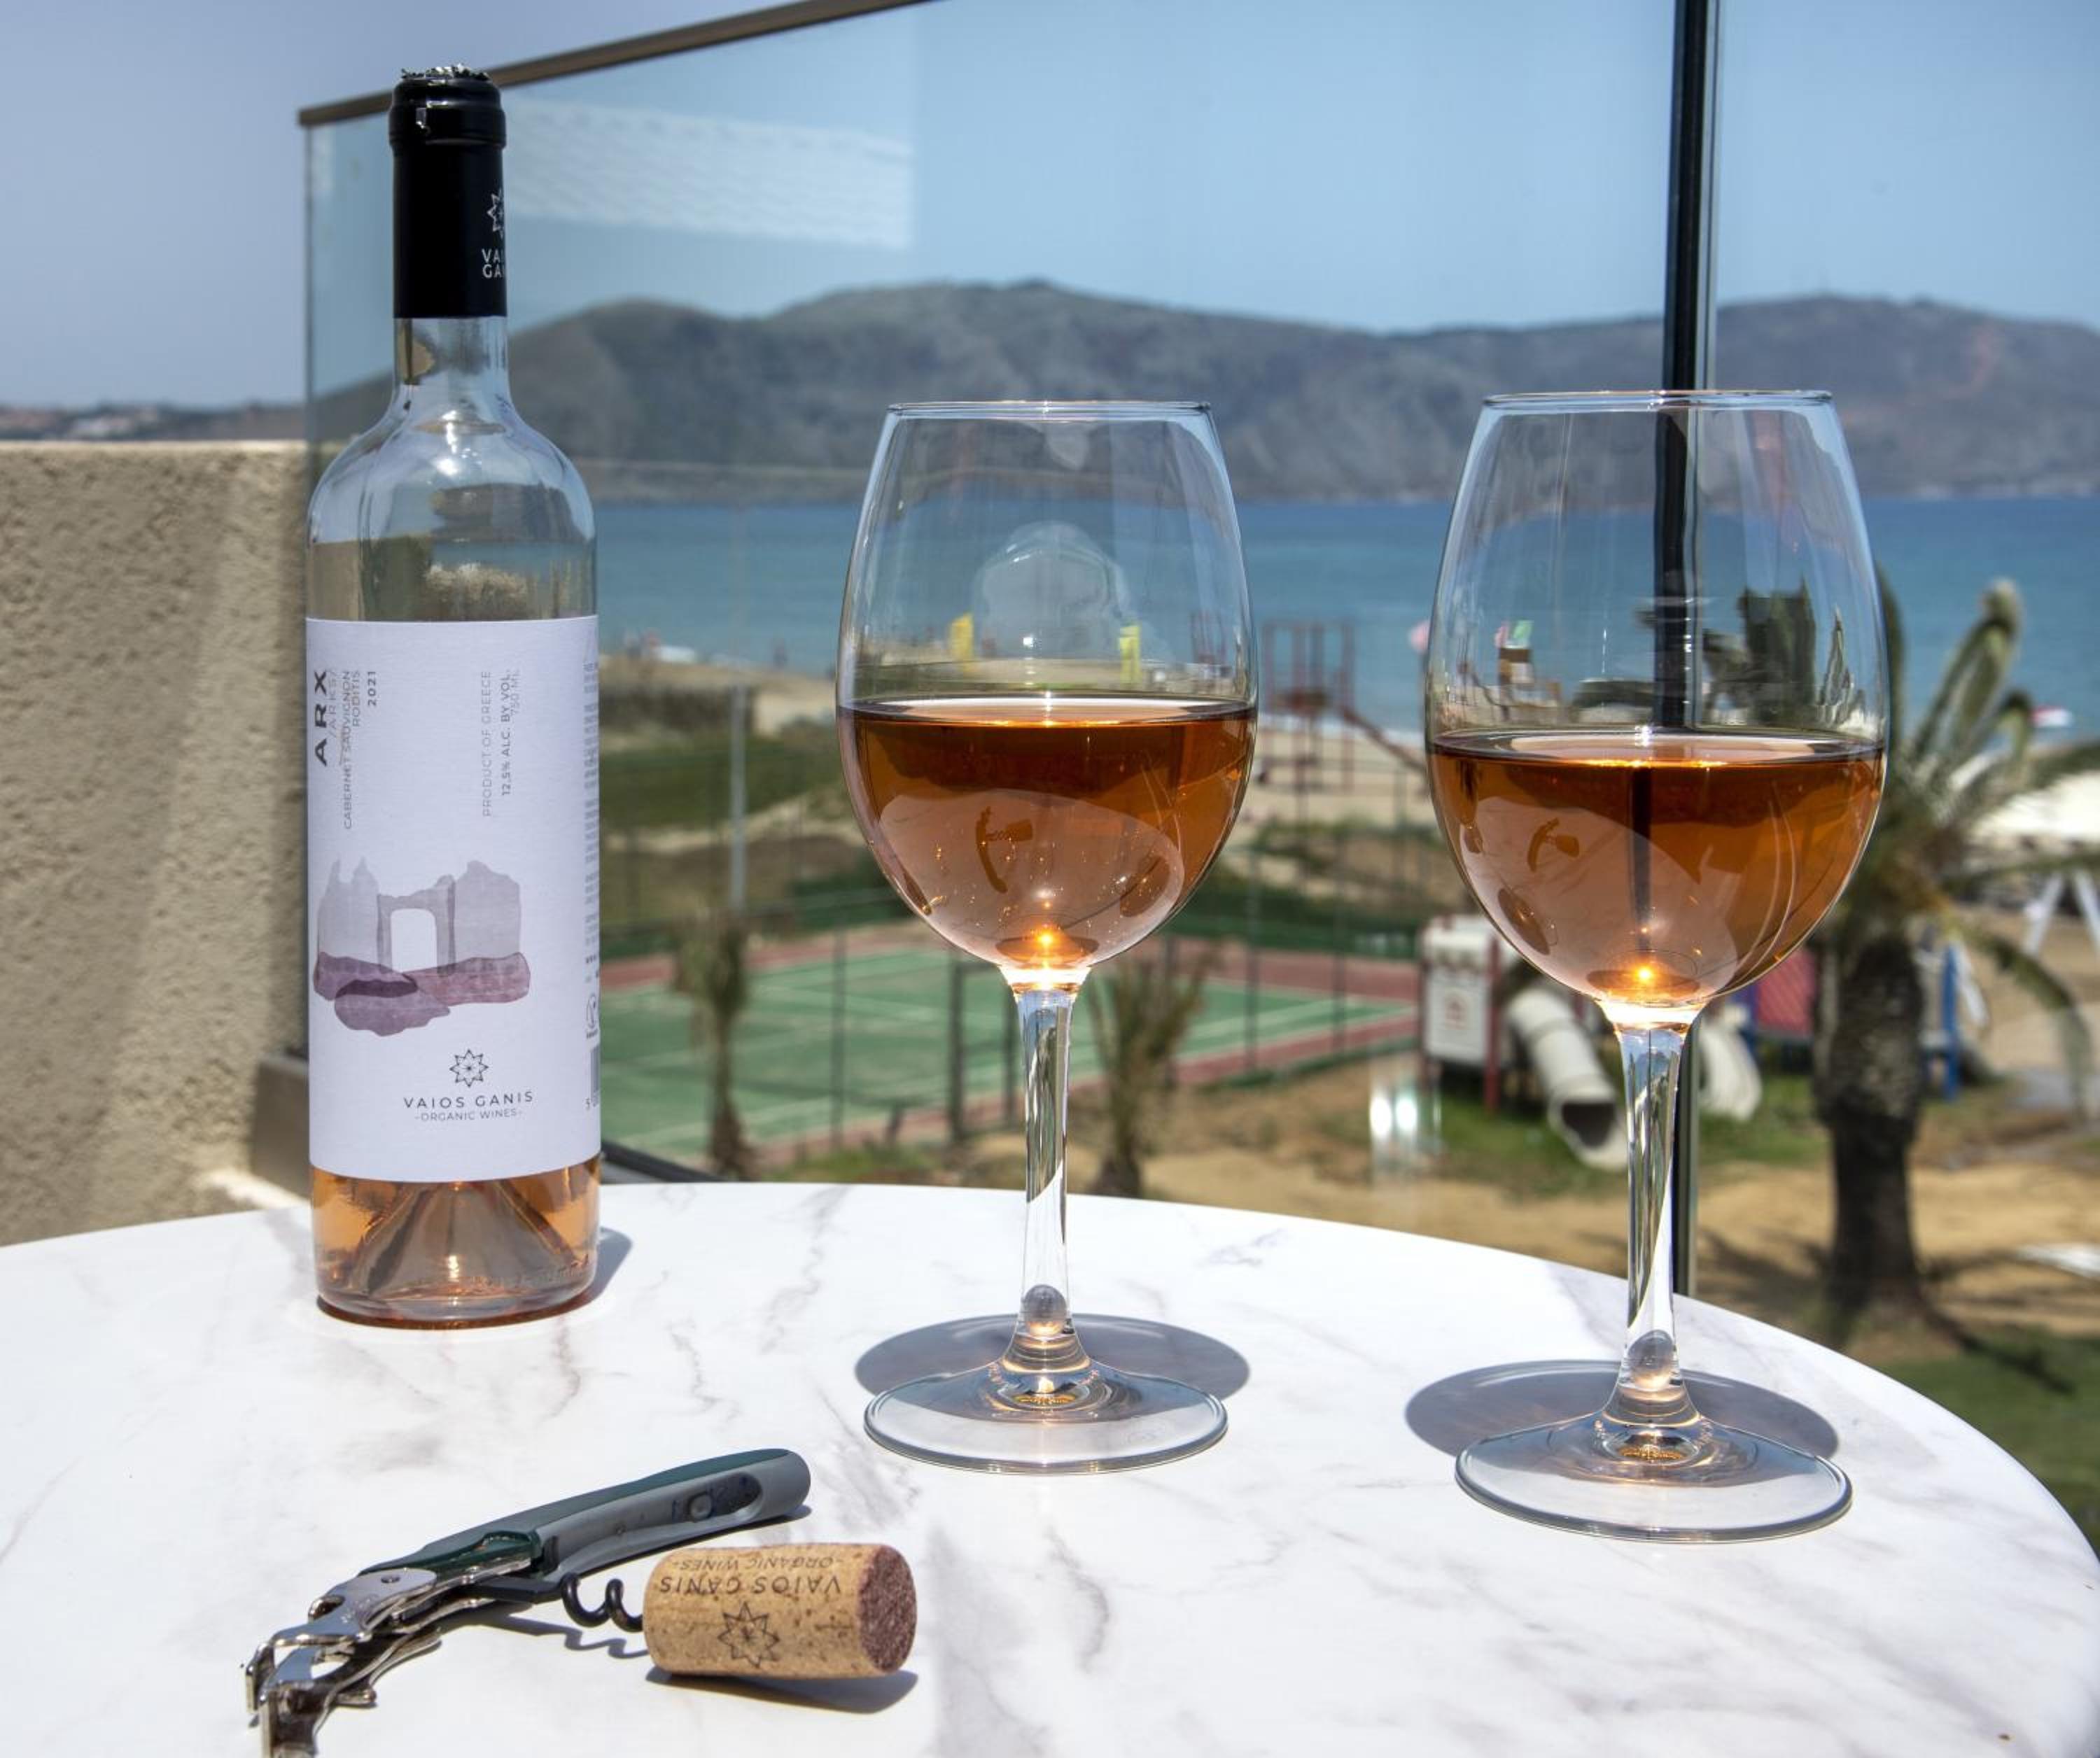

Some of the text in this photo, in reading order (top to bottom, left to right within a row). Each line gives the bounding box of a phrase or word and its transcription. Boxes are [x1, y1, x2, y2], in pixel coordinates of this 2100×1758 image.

[351, 670, 360, 727] RODITIS
[368, 671, 377, 706] 2021
[314, 670, 327, 767] ARX
[501, 705, 511, 723] BY
[342, 671, 352, 829] CABERNET SAUVIGNON
[481, 671, 492, 817] PRODUCT OF GREECE
[501, 727, 511, 757] ALC.
[403, 1090, 533, 1109] VAIOS GANIS
[660, 1576, 841, 1595] VAIOS GANIS
